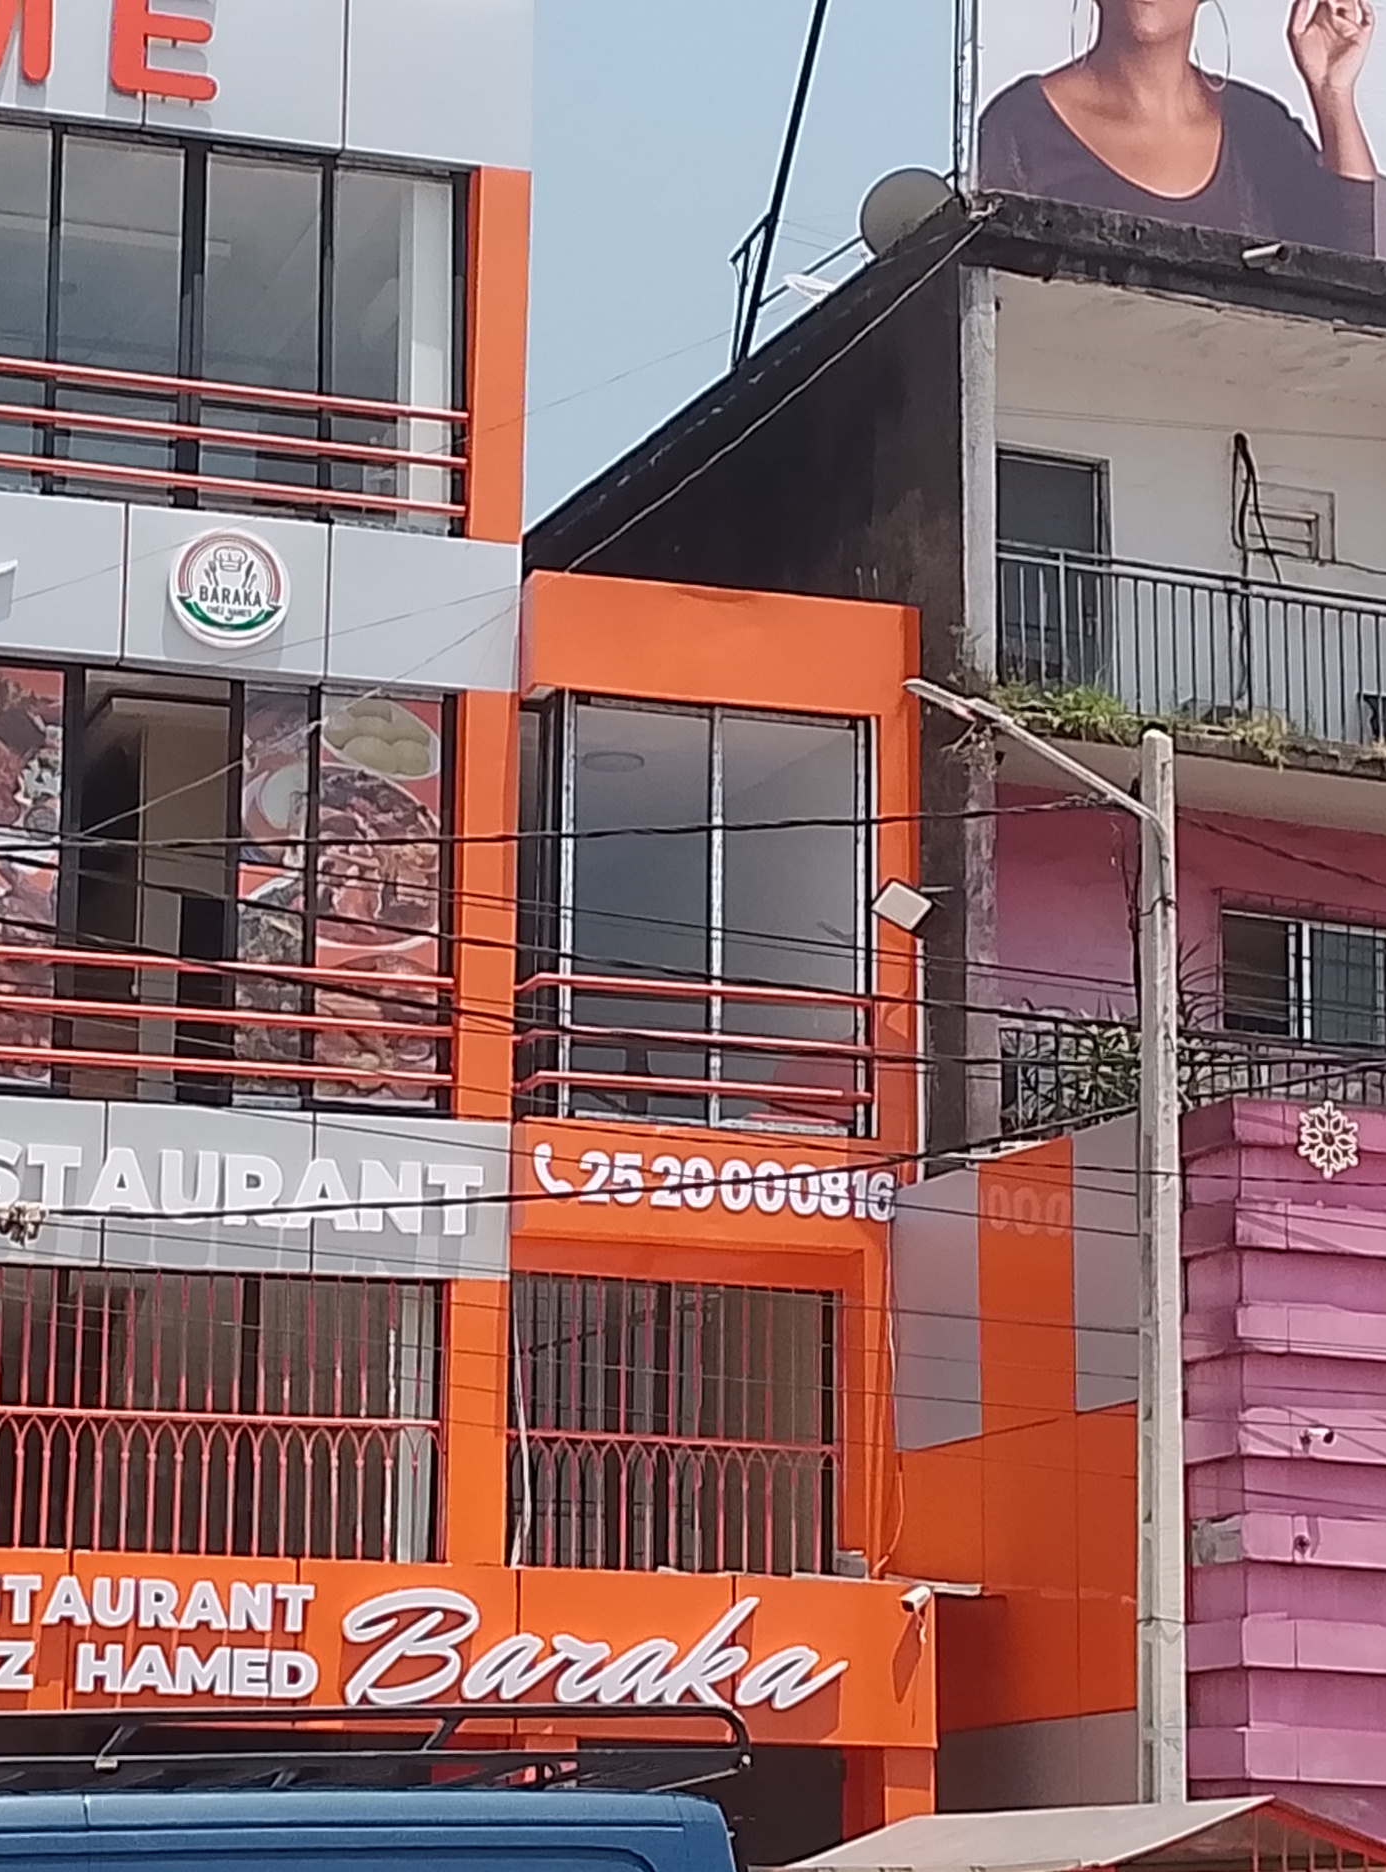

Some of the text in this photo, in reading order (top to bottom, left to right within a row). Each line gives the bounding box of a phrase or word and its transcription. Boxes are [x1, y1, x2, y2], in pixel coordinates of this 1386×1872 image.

[199, 584, 262, 608] BARAKA
[579, 1150, 644, 1206] 25
[650, 1154, 715, 1210] 20
[74, 1642, 319, 1698] HAMED
[342, 1586, 852, 1711] Baraka
